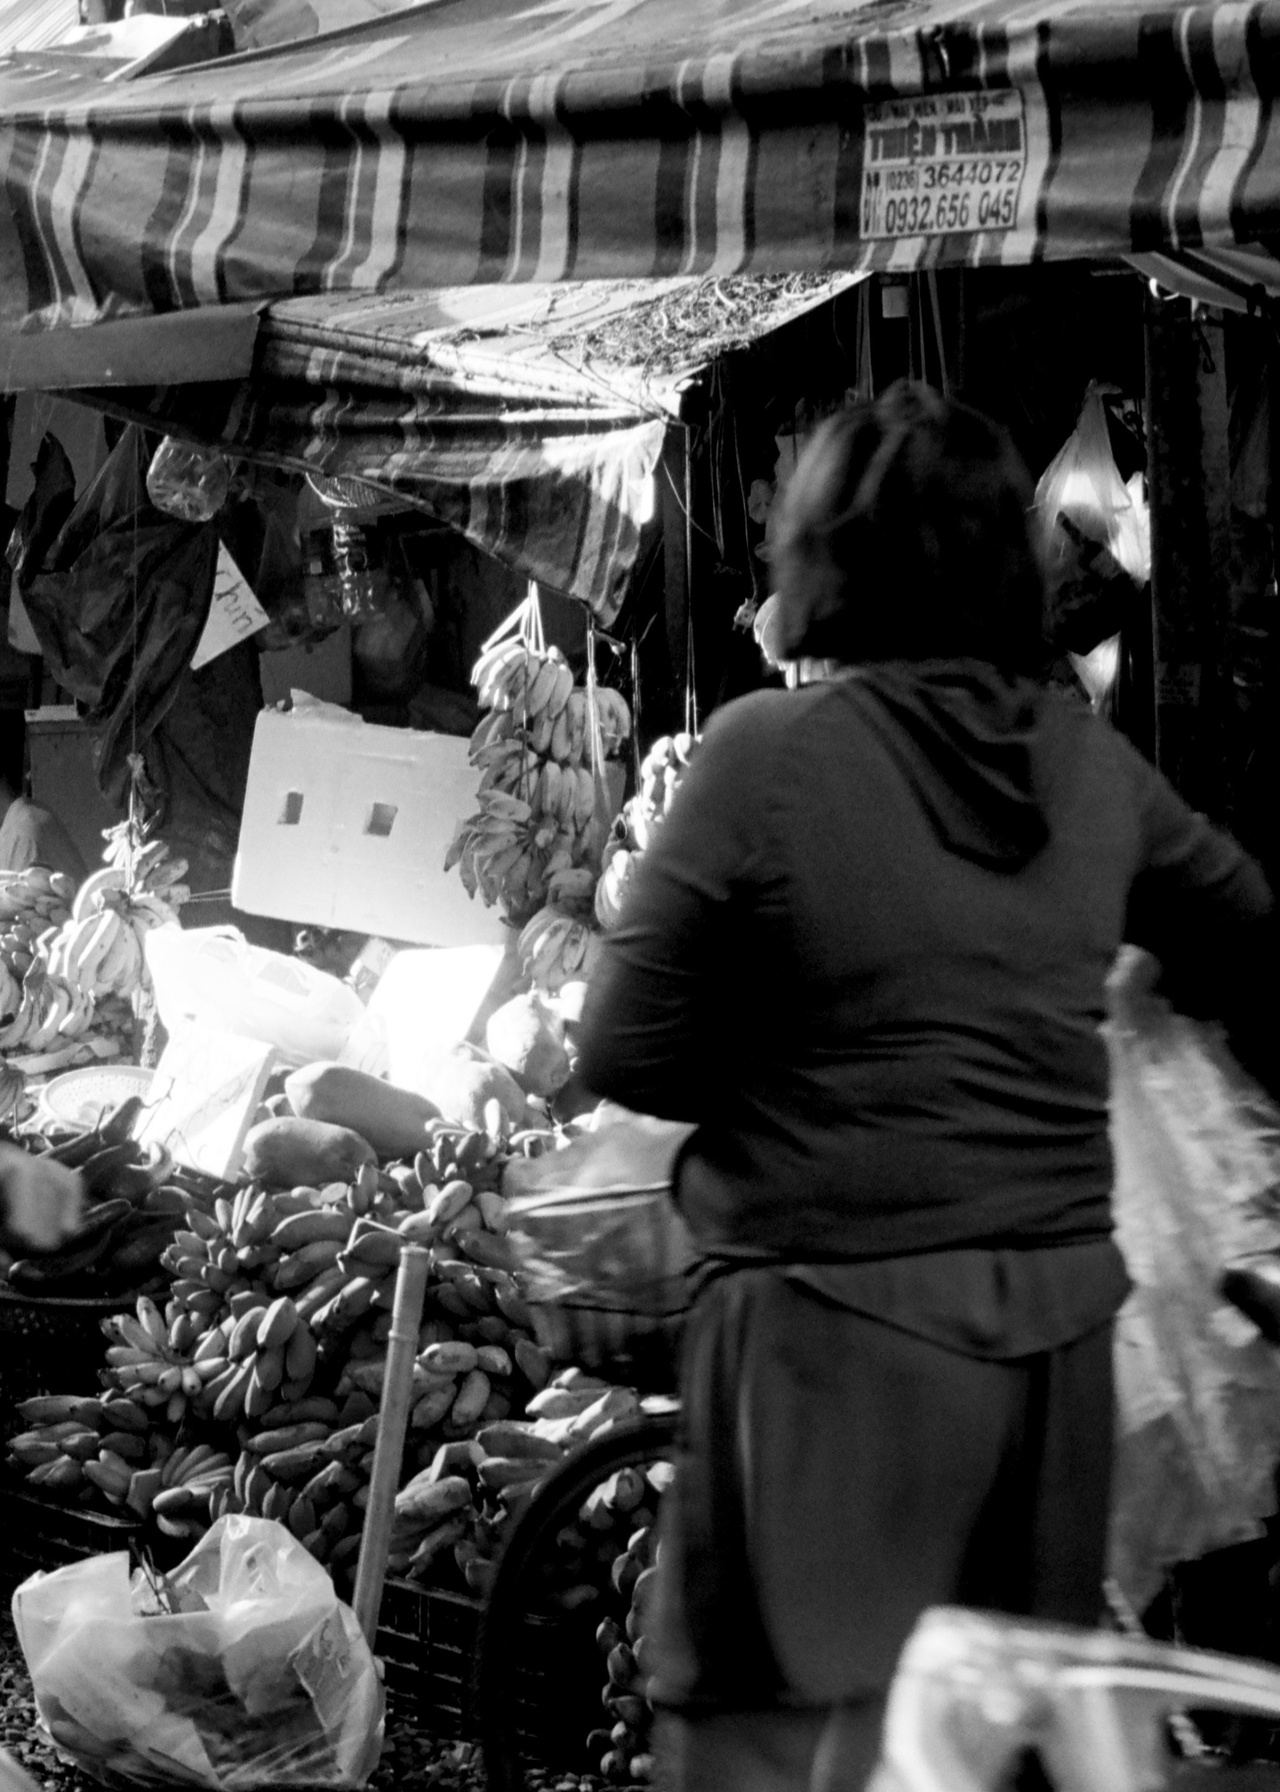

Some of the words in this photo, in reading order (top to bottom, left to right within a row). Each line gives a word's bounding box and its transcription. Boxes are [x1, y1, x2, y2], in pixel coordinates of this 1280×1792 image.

[923, 160, 1021, 189] 3644072
[885, 192, 970, 234] 0932.656
[978, 188, 1015, 225] 045
